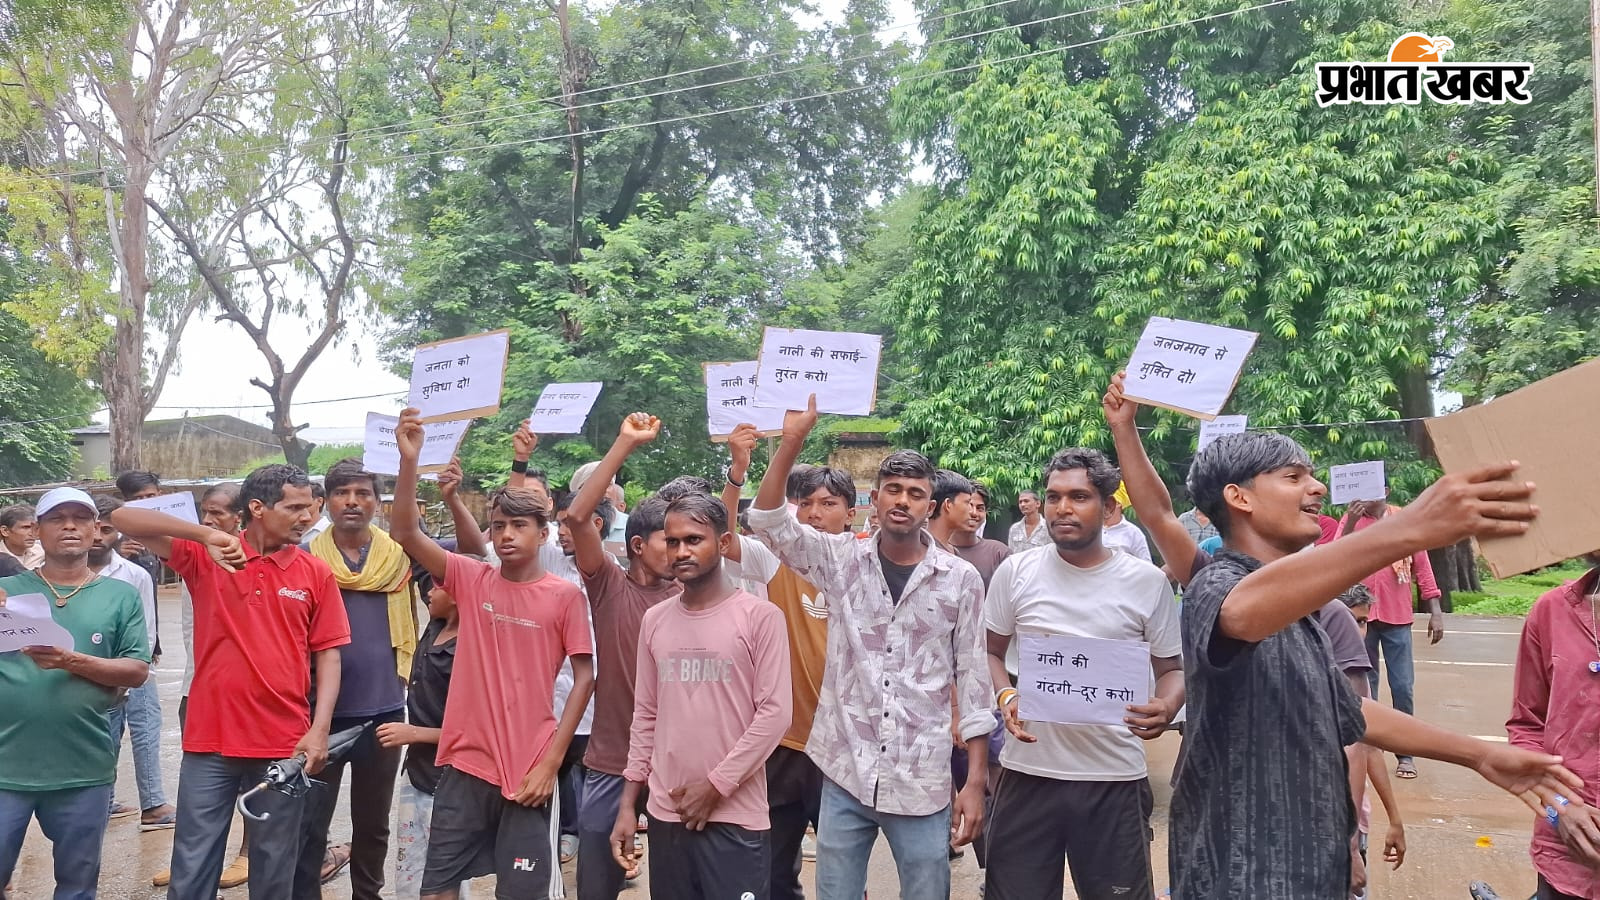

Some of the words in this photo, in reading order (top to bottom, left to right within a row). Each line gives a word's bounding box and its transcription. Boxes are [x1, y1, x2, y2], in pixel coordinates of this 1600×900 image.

[778, 344, 805, 358] नाली
[809, 345, 825, 359] की
[1152, 335, 1211, 357] जलजमाव
[1213, 345, 1229, 361] से
[424, 357, 453, 373] जनता
[457, 353, 471, 367] को
[1139, 360, 1174, 380] मुक्ति
[1176, 368, 1197, 384] दो!
[720, 376, 744, 388] नाली
[775, 365, 799, 383] तुरंत
[804, 369, 828, 382] करो!
[421, 379, 453, 400] सुविधा
[456, 376, 471, 390] दो!
[721, 395, 748, 408] करनी
[1036, 651, 1065, 667] गली
[1071, 653, 1090, 669] की
[680, 656, 734, 684] BRAVE
[1105, 686, 1135, 703] करो!
